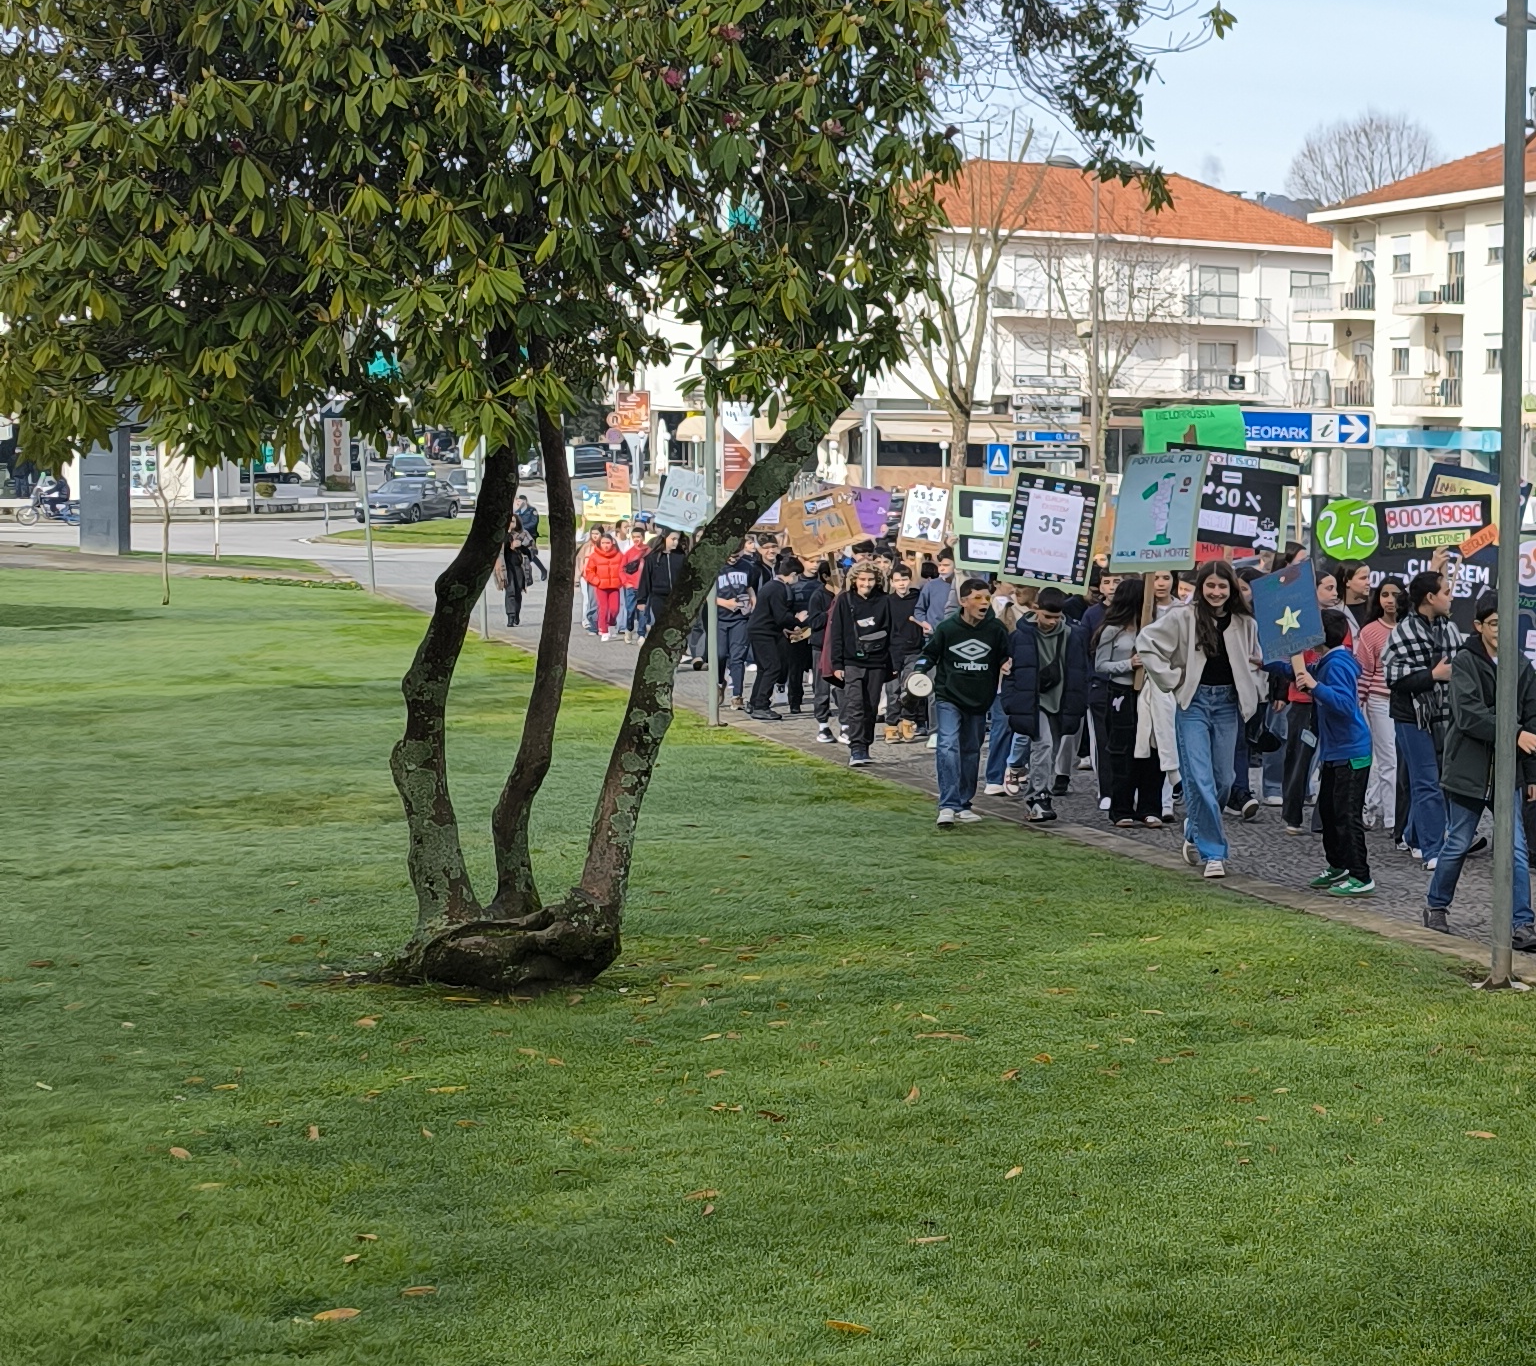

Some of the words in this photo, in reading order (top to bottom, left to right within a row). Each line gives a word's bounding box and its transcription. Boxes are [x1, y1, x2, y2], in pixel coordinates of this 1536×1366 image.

[1244, 425, 1309, 440] GEOPARK
[1131, 454, 1175, 466] PORTUGAL
[1038, 514, 1066, 536] 35
[1420, 532, 1466, 547] INTERNET
[1462, 530, 1497, 556] SEGURA
[1140, 548, 1162, 560] PENA
[1163, 547, 1190, 558] MORTE
[953, 660, 989, 672] umbro
